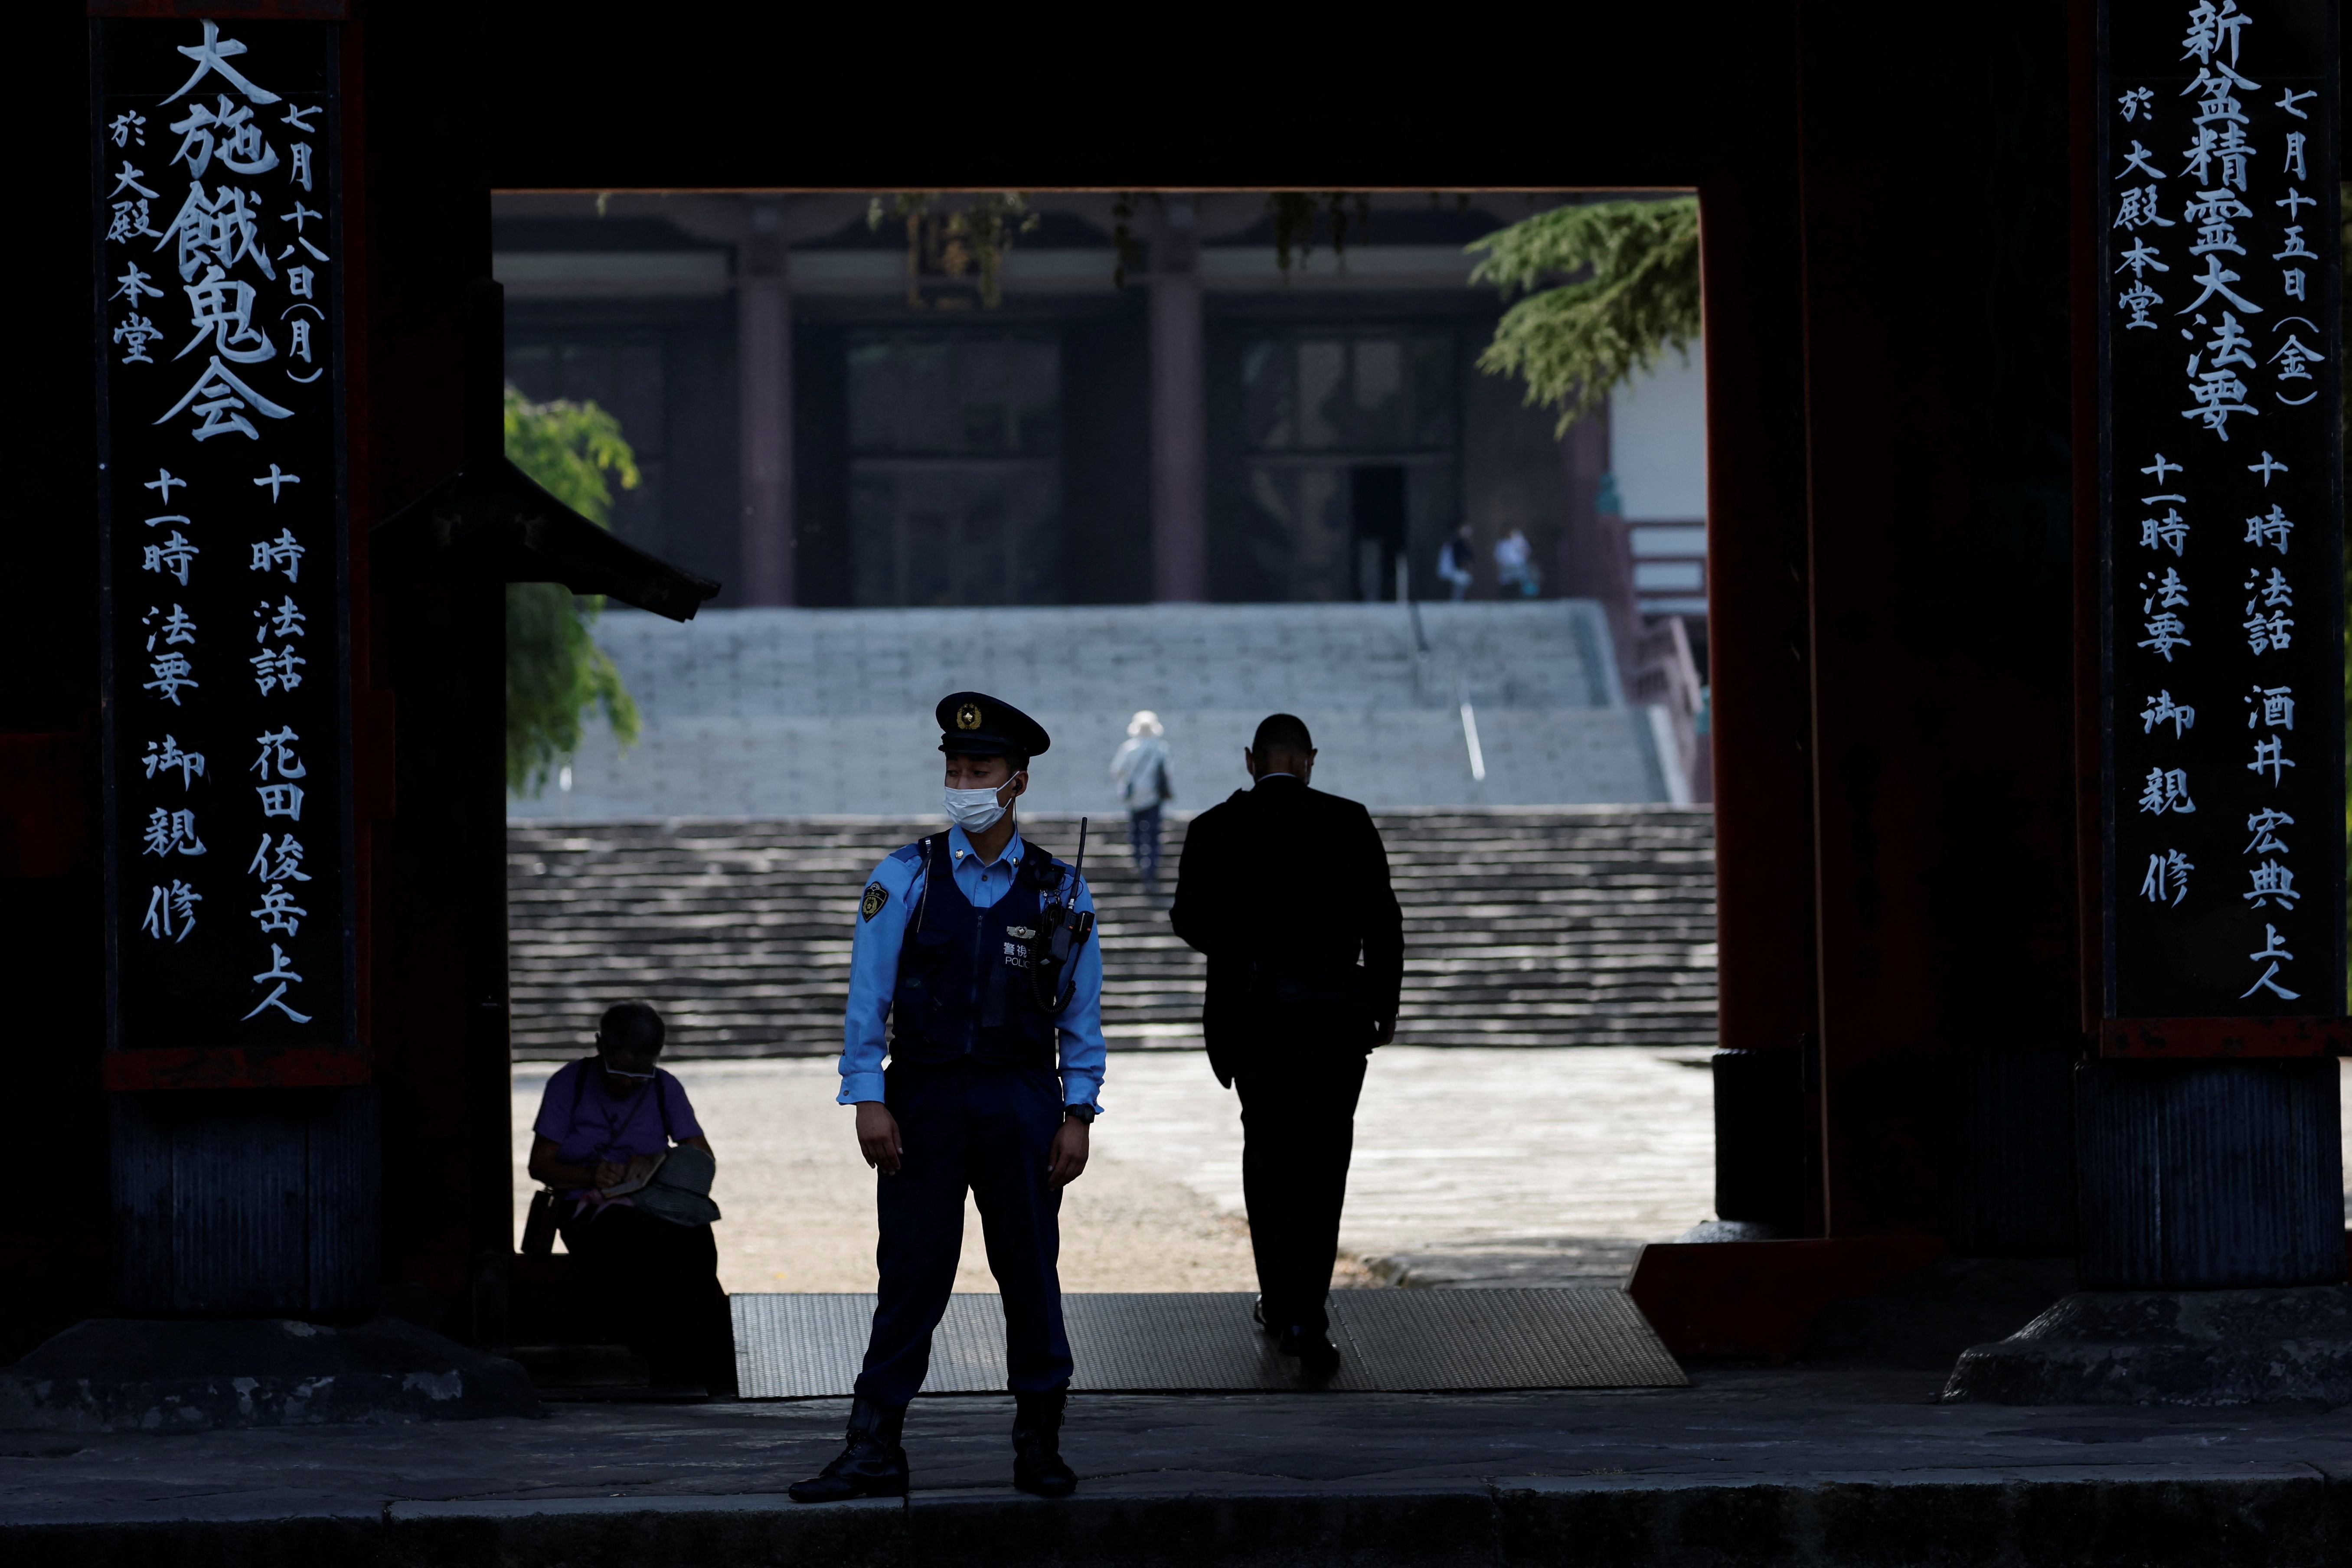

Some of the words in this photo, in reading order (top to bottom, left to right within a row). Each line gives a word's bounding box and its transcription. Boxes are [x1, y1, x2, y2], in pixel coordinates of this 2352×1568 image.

[105, 109, 163, 364] 於大殿本堂
[154, 20, 295, 441] 大施餓鬼会
[2113, 86, 2176, 330] 於大殿本堂
[2177, 0, 2264, 441] 新盆精霊大法要
[1003, 942, 1031, 958] 警視
[1005, 956, 1030, 969] POLIC
